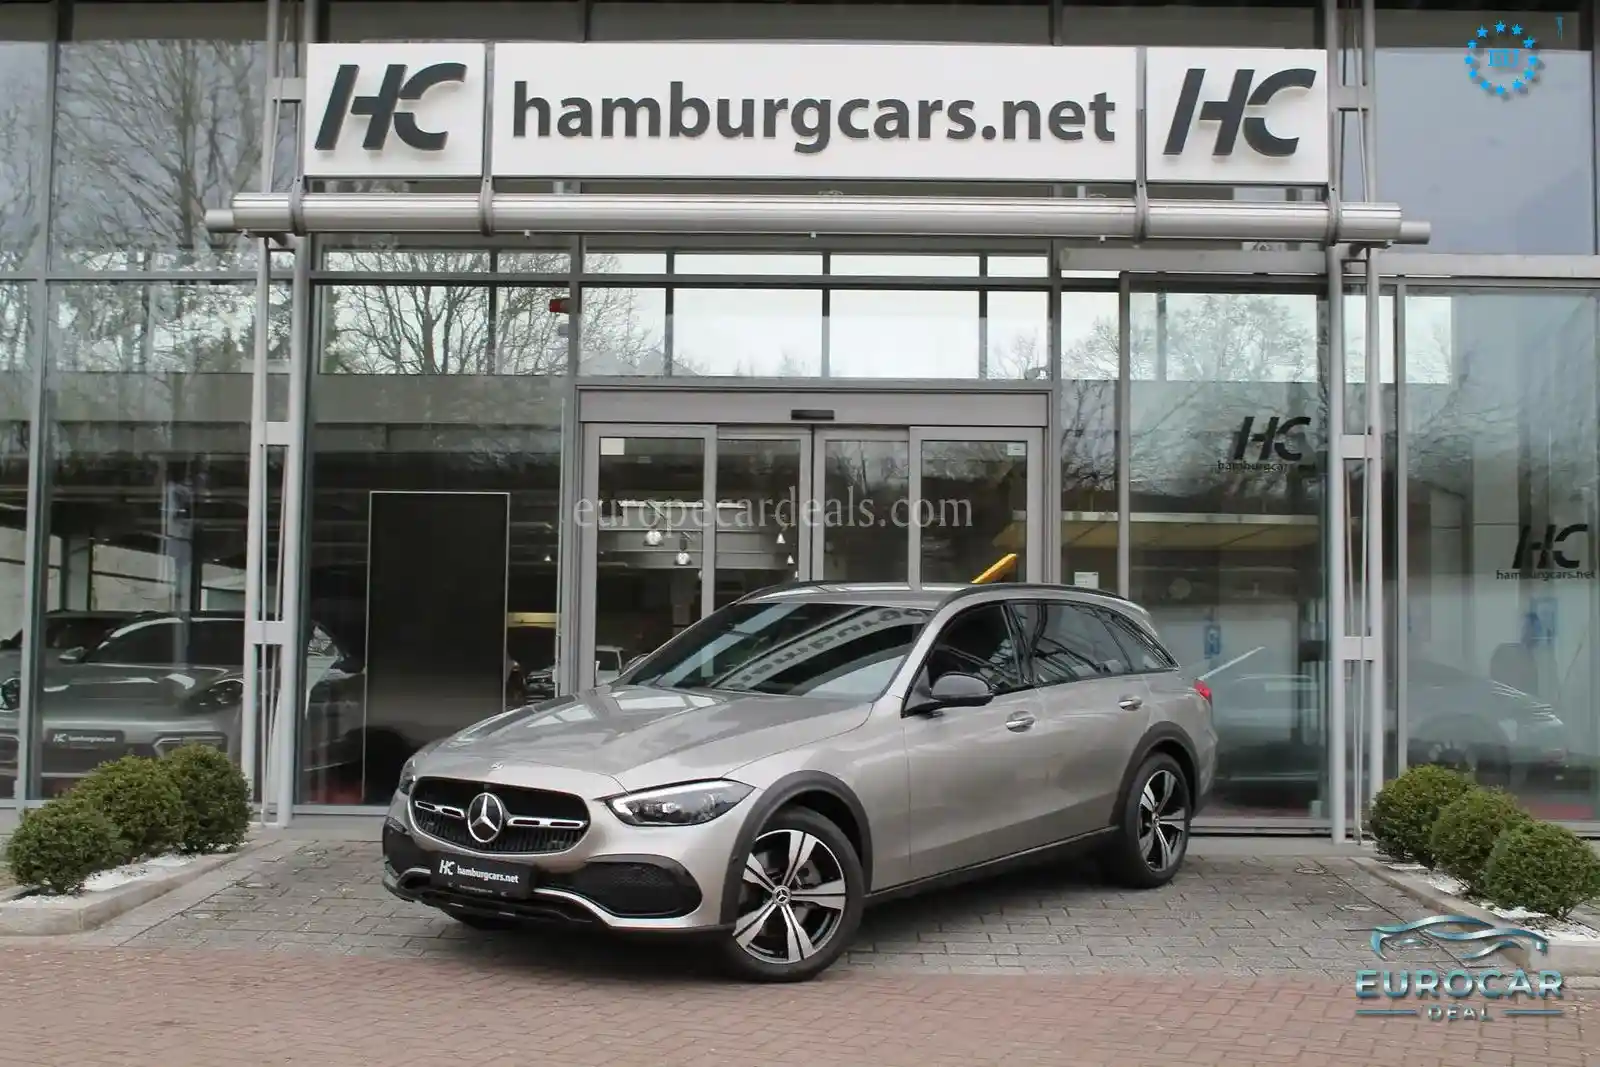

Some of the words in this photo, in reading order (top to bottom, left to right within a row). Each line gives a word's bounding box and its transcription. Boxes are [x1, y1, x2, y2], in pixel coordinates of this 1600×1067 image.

[315, 62, 467, 151] HC
[512, 80, 1116, 154] hamburgcars.net
[1162, 68, 1317, 157] HC
[1233, 415, 1312, 460] HC
[1511, 523, 1589, 569] HC
[438, 859, 456, 876] HC
[457, 864, 519, 884] hamburgcars.net
